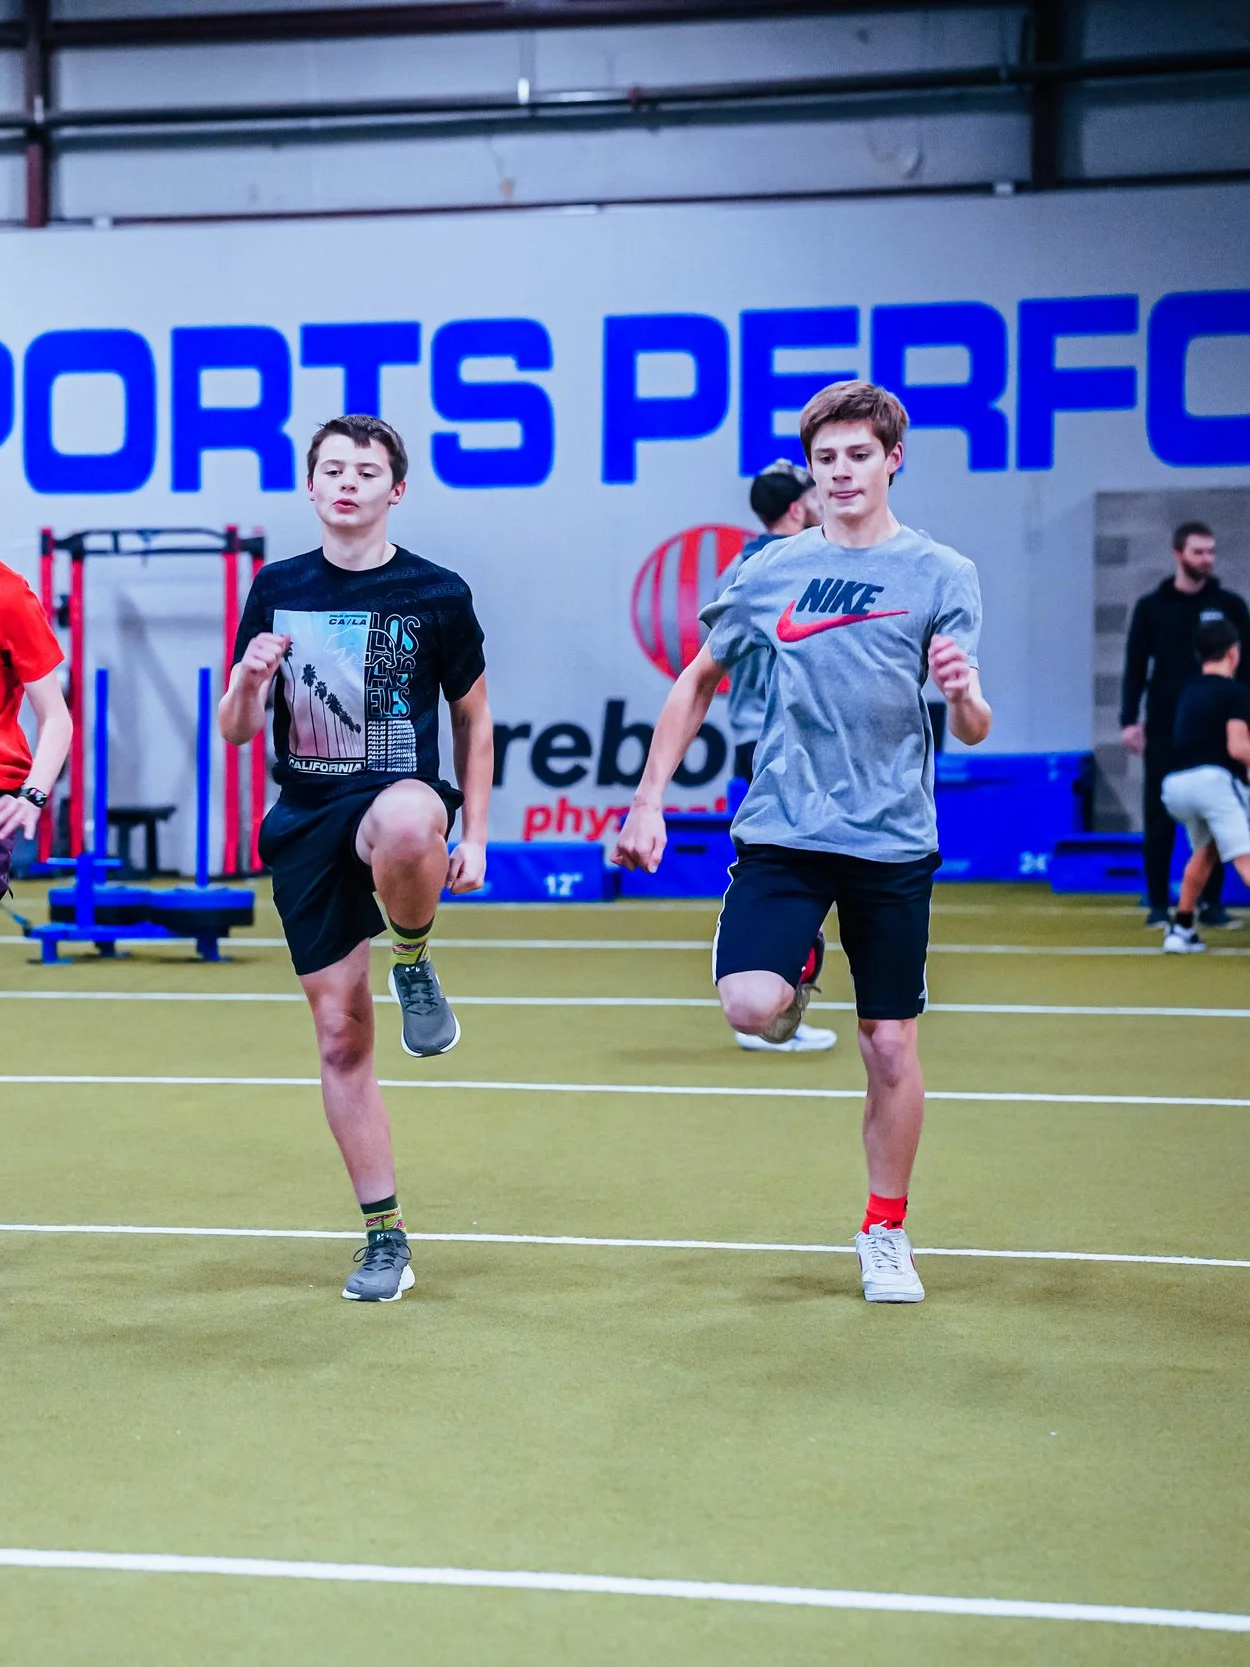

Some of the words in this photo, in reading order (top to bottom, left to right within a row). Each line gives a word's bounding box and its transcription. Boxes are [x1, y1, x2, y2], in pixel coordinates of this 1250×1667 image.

[796, 578, 885, 615] NIKE
[329, 618, 367, 626] CA/LA
[493, 697, 728, 789] rebo
[289, 758, 362, 773] CALIFORNIA
